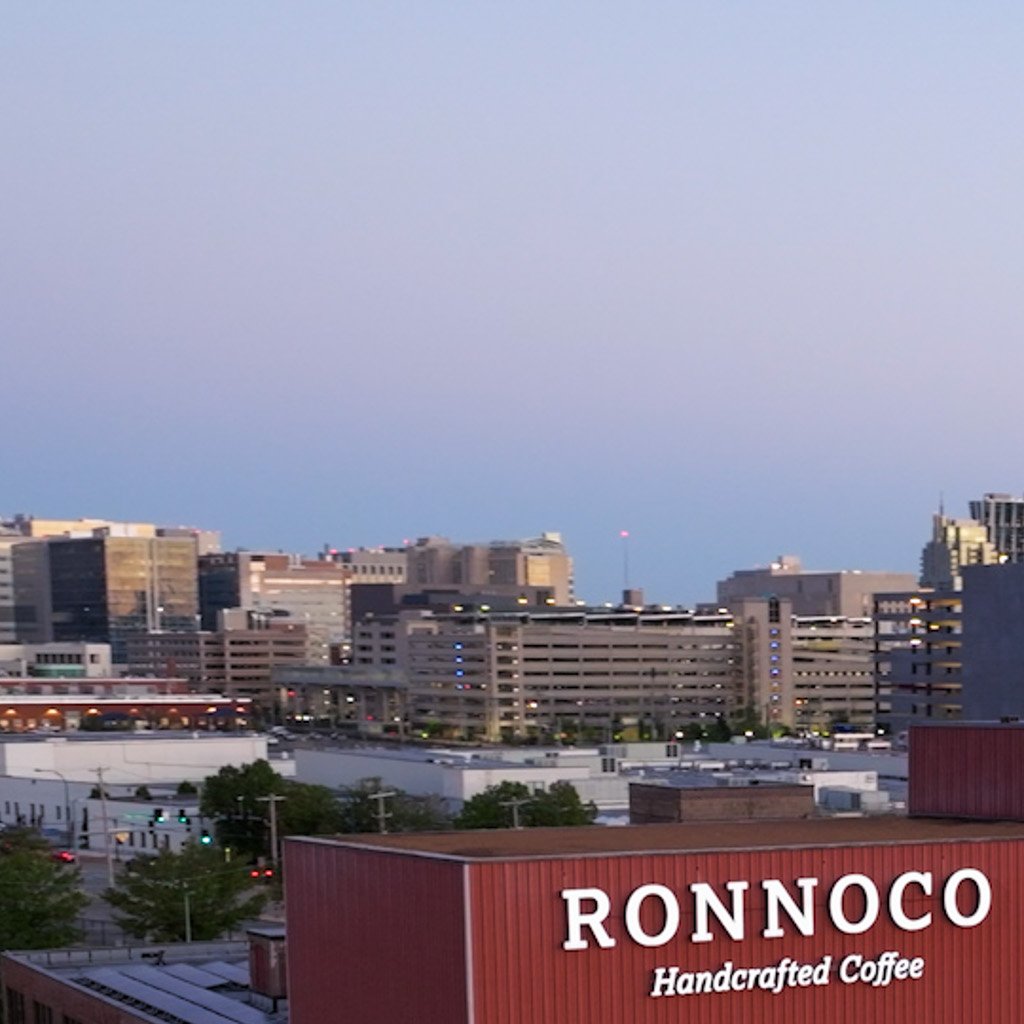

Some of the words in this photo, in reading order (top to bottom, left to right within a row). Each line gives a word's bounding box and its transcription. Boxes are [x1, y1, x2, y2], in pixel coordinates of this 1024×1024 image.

[561, 868, 992, 951] RONNOCO
[650, 956, 832, 997] Handcrafted
[839, 951, 925, 987] Coffee
